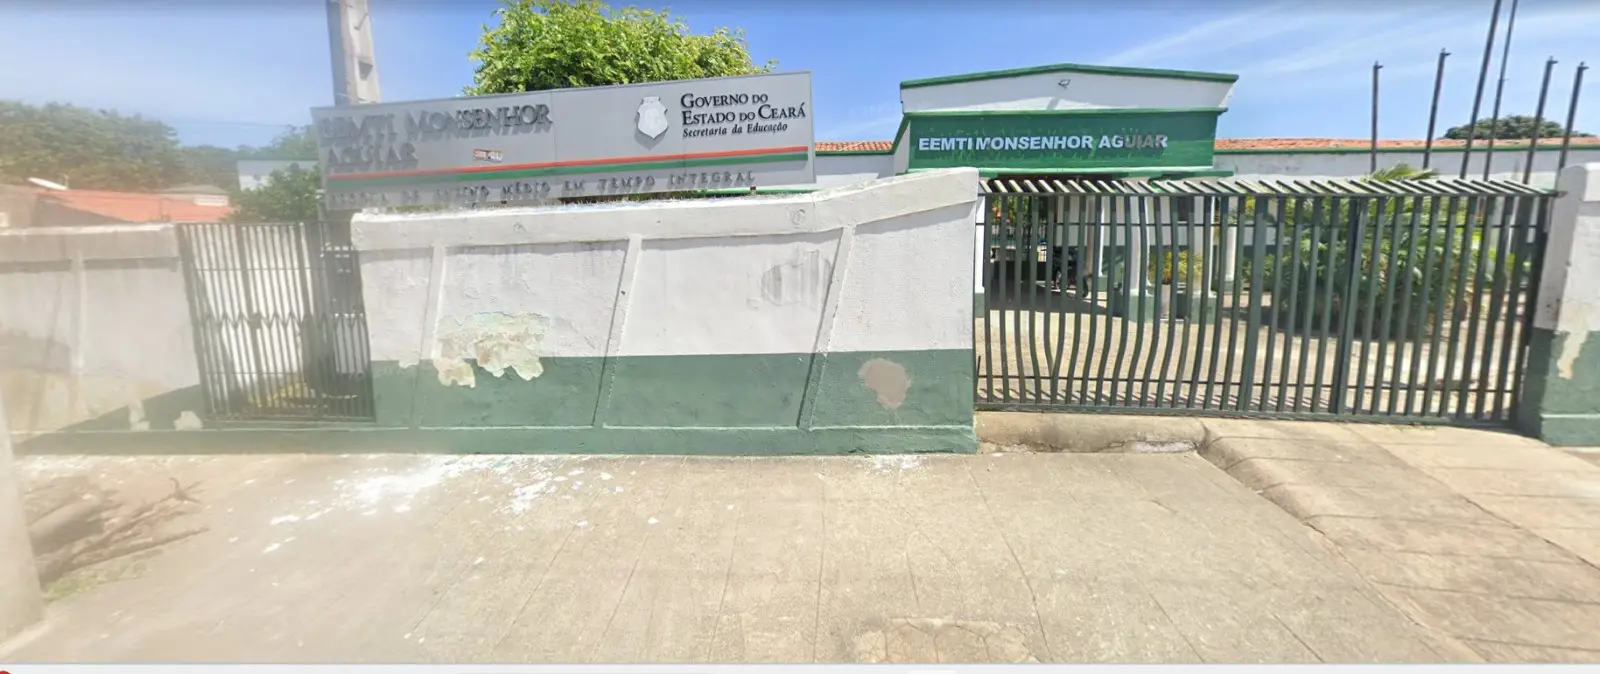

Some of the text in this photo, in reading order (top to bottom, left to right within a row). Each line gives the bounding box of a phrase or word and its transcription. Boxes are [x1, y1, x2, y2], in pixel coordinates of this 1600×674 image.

[680, 93, 769, 109] GOVERNO DO
[406, 103, 553, 133] MONSENHOR
[682, 102, 807, 126] ESTADO DO CEARÁ
[682, 121, 788, 138] Secretaria da Educação
[918, 134, 1168, 151] EEMTI MONSENHOR AGUIAR
[599, 174, 655, 189] TEMPO
[670, 171, 755, 186] INTEGRAL
